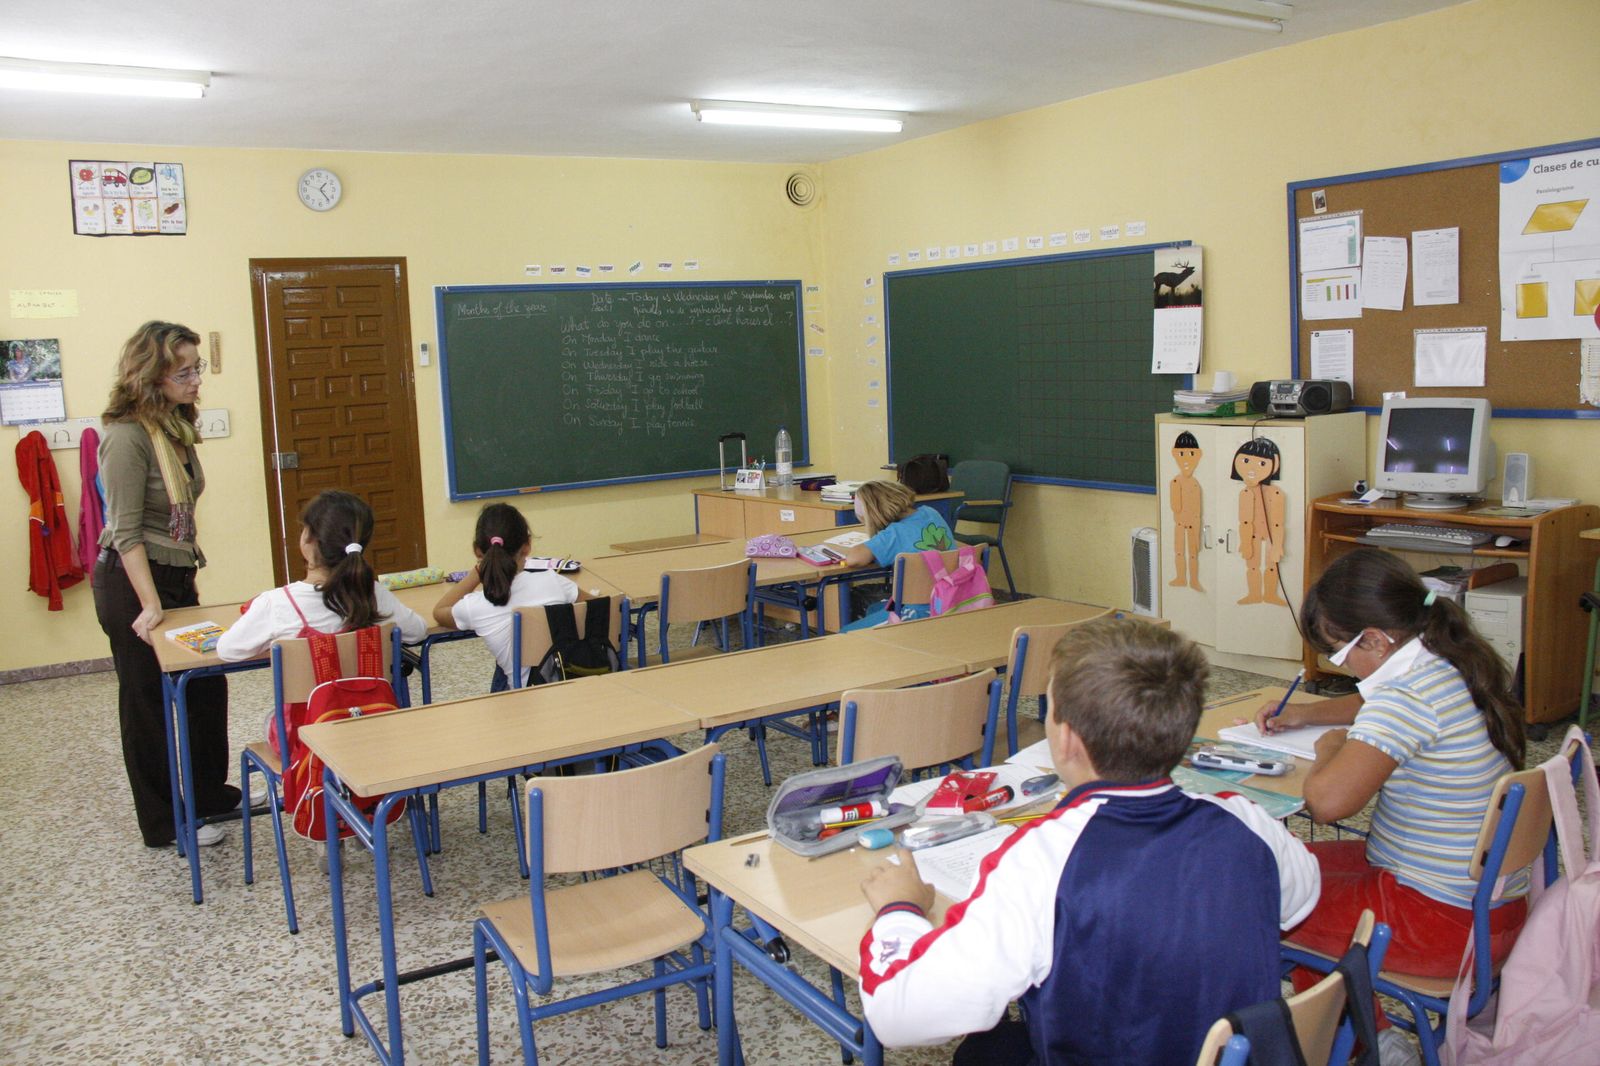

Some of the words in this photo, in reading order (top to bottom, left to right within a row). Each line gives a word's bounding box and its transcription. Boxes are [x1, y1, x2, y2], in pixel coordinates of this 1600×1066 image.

[1533, 163, 1567, 174] Clases
[1570, 159, 1583, 169] de
[592, 291, 612, 305] Date
[626, 291, 659, 310] Today
[673, 290, 720, 304] Wednesday
[741, 289, 775, 304] September
[779, 291, 794, 301] 2009
[457, 300, 490, 317] Months
[493, 300, 503, 320] of
[506, 299, 520, 313] the
[560, 315, 590, 333] What
[597, 315, 610, 329] do
[614, 319, 634, 336] you
[638, 317, 651, 329] do
[562, 334, 577, 345] On
[581, 332, 617, 350] Monday
[561, 347, 577, 357] On
[584, 346, 623, 361] Tuesday
[626, 345, 635, 355] I
[640, 344, 664, 361] play
[561, 360, 577, 370] On
[583, 361, 633, 376] Wednesday
[561, 371, 577, 382] On
[586, 370, 632, 388] Thursday
[635, 371, 644, 382] I
[648, 374, 660, 387] go
[562, 383, 579, 396] On
[585, 383, 623, 401] Friday
[631, 384, 640, 394] I
[659, 384, 670, 395] to
[562, 398, 580, 410] On
[585, 398, 628, 418] Saturday
[632, 398, 640, 412] I
[644, 397, 665, 418] play
[668, 397, 704, 418] football
[563, 412, 581, 427] On
[589, 415, 623, 436] Sunday
[631, 417, 641, 428] I
[646, 416, 666, 437] play
